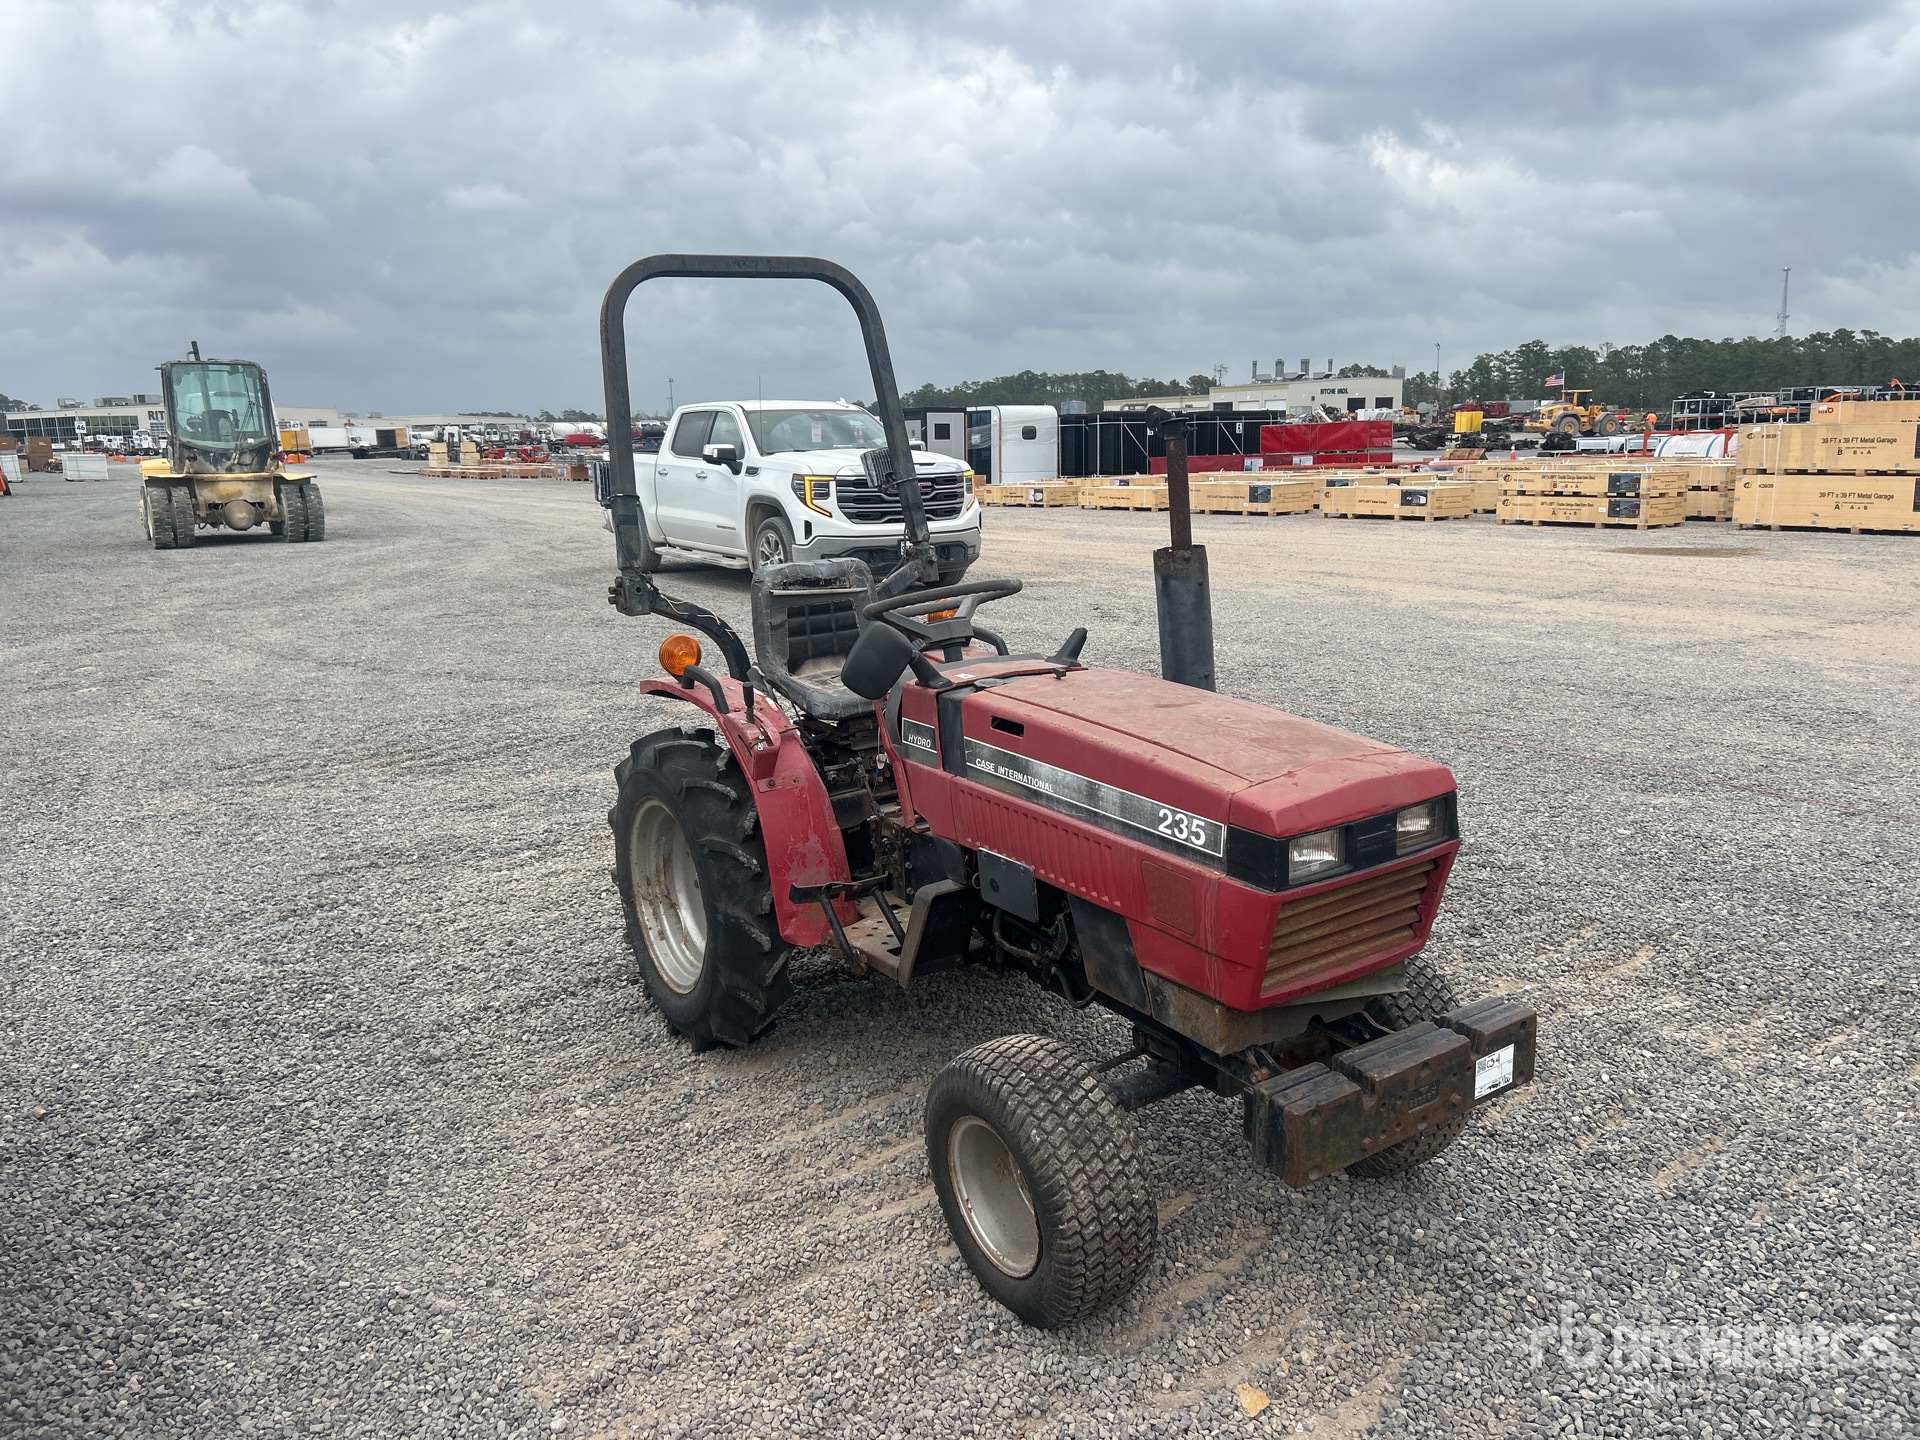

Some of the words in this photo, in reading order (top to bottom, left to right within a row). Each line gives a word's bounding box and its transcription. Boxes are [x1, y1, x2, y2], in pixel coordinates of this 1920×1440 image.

[1874, 492, 1894, 500] Garage
[908, 733, 931, 749] HYDRO
[975, 758, 995, 772] CASE
[997, 765, 1054, 793] INTERNATIONAL
[1157, 808, 1206, 846] 235
